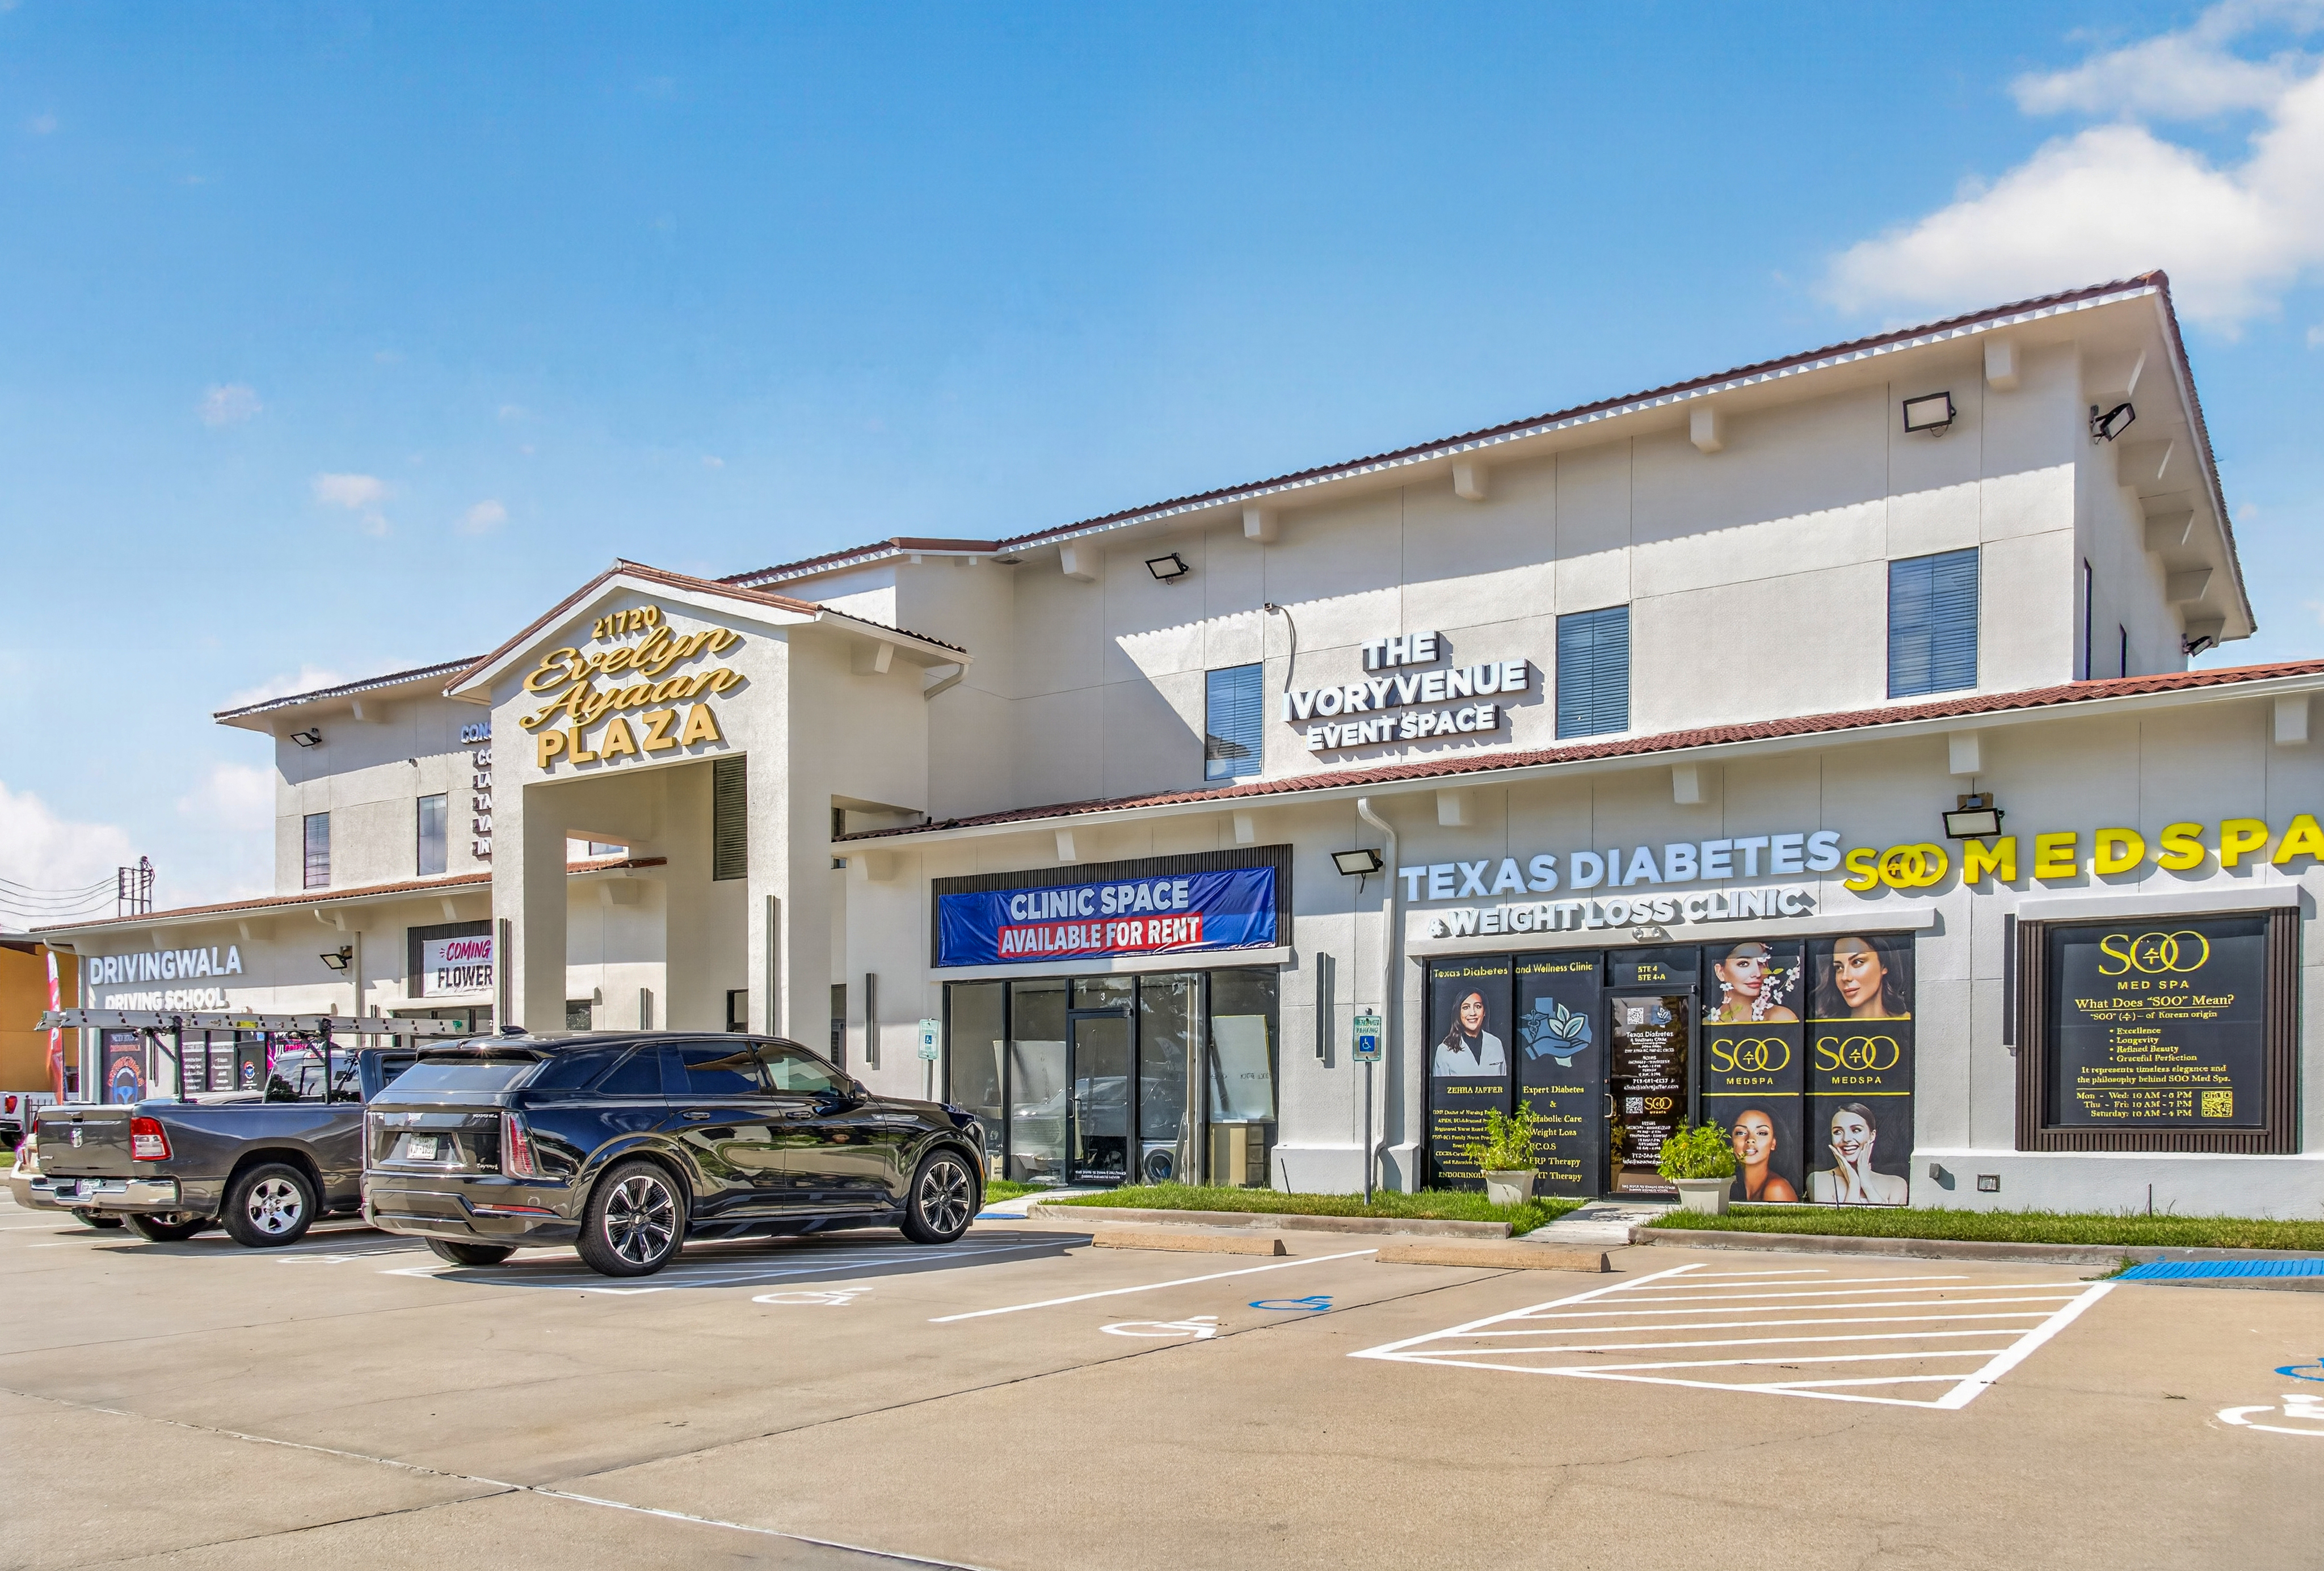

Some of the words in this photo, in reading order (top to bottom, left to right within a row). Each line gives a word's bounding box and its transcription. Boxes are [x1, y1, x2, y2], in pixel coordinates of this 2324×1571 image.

[592, 605, 660, 638] 21720
[523, 625, 741, 691] Evelyn
[1362, 630, 1439, 670] THE
[519, 668, 746, 728] Ayaan
[538, 704, 719, 768] PLAZA
[1307, 716, 1397, 751] EVENT
[1400, 704, 1500, 739] SPACE
[1398, 855, 1559, 902] TEXAS
[1570, 830, 1841, 890] DIABETES
[1843, 843, 1948, 891] SOO
[1011, 888, 1094, 921] CLINIC
[1101, 880, 1189, 914] SPACE
[1447, 903, 1579, 937] WEIGHT
[1585, 896, 1675, 927] LOSS
[1683, 888, 1805, 921] CLINIC
[447, 940, 491, 961] COMING
[1001, 923, 1101, 954] AVAILABLE
[1106, 921, 1143, 947] FOR
[1148, 917, 1200, 945] RENT
[90, 945, 242, 985] DRIVINGWALA
[2099, 930, 2211, 975] SOO
[438, 965, 492, 988] FLOWER
[1433, 968, 1460, 978] Texas
[1463, 966, 1508, 977] Diabetes
[1515, 964, 1531, 974] and
[1533, 963, 1567, 973] Wellness
[1569, 962, 1593, 971] Clinic
[2117, 981, 2151, 990] MED
[2159, 980, 2189, 989] SPA
[105, 991, 162, 1011] DRIVING
[164, 987, 226, 1011] SCHOOL
[1101, 992, 1105, 1001] 3
[2075, 998, 2108, 1009] What
[2112, 997, 2144, 1008] Does
[2192, 994, 2234, 1005] Mean?
[2191, 1010, 2217, 1019] origin
[1711, 1037, 1790, 1072] SOO
[1815, 1035, 1899, 1071] SOO
[2150, 1046, 2179, 1054] Beauty
[2092, 1076, 2136, 1084] philosophy
[2172, 1065, 2208, 1074] elegance
[1523, 1086, 1550, 1096] Expert
[1548, 1157, 1581, 1168] Therapy
[1550, 1172, 1582, 1182] Therapy
